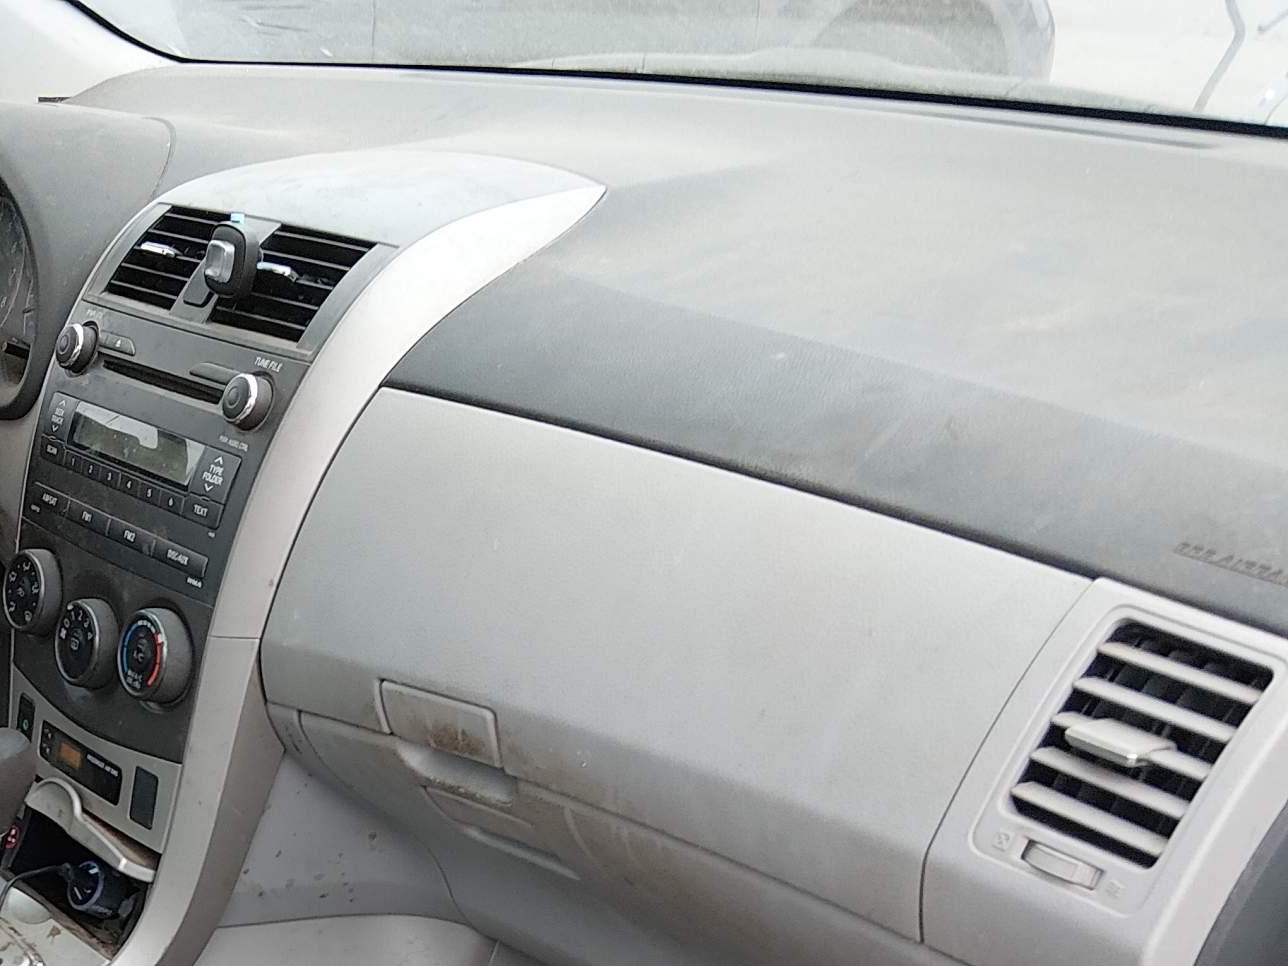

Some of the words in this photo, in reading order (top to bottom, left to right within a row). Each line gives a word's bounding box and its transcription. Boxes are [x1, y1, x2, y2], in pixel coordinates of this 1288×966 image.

[209, 464, 224, 477] TYPE
[202, 471, 224, 486] FOLDER
[193, 504, 209, 517] TEXT
[123, 530, 136, 542] FM2
